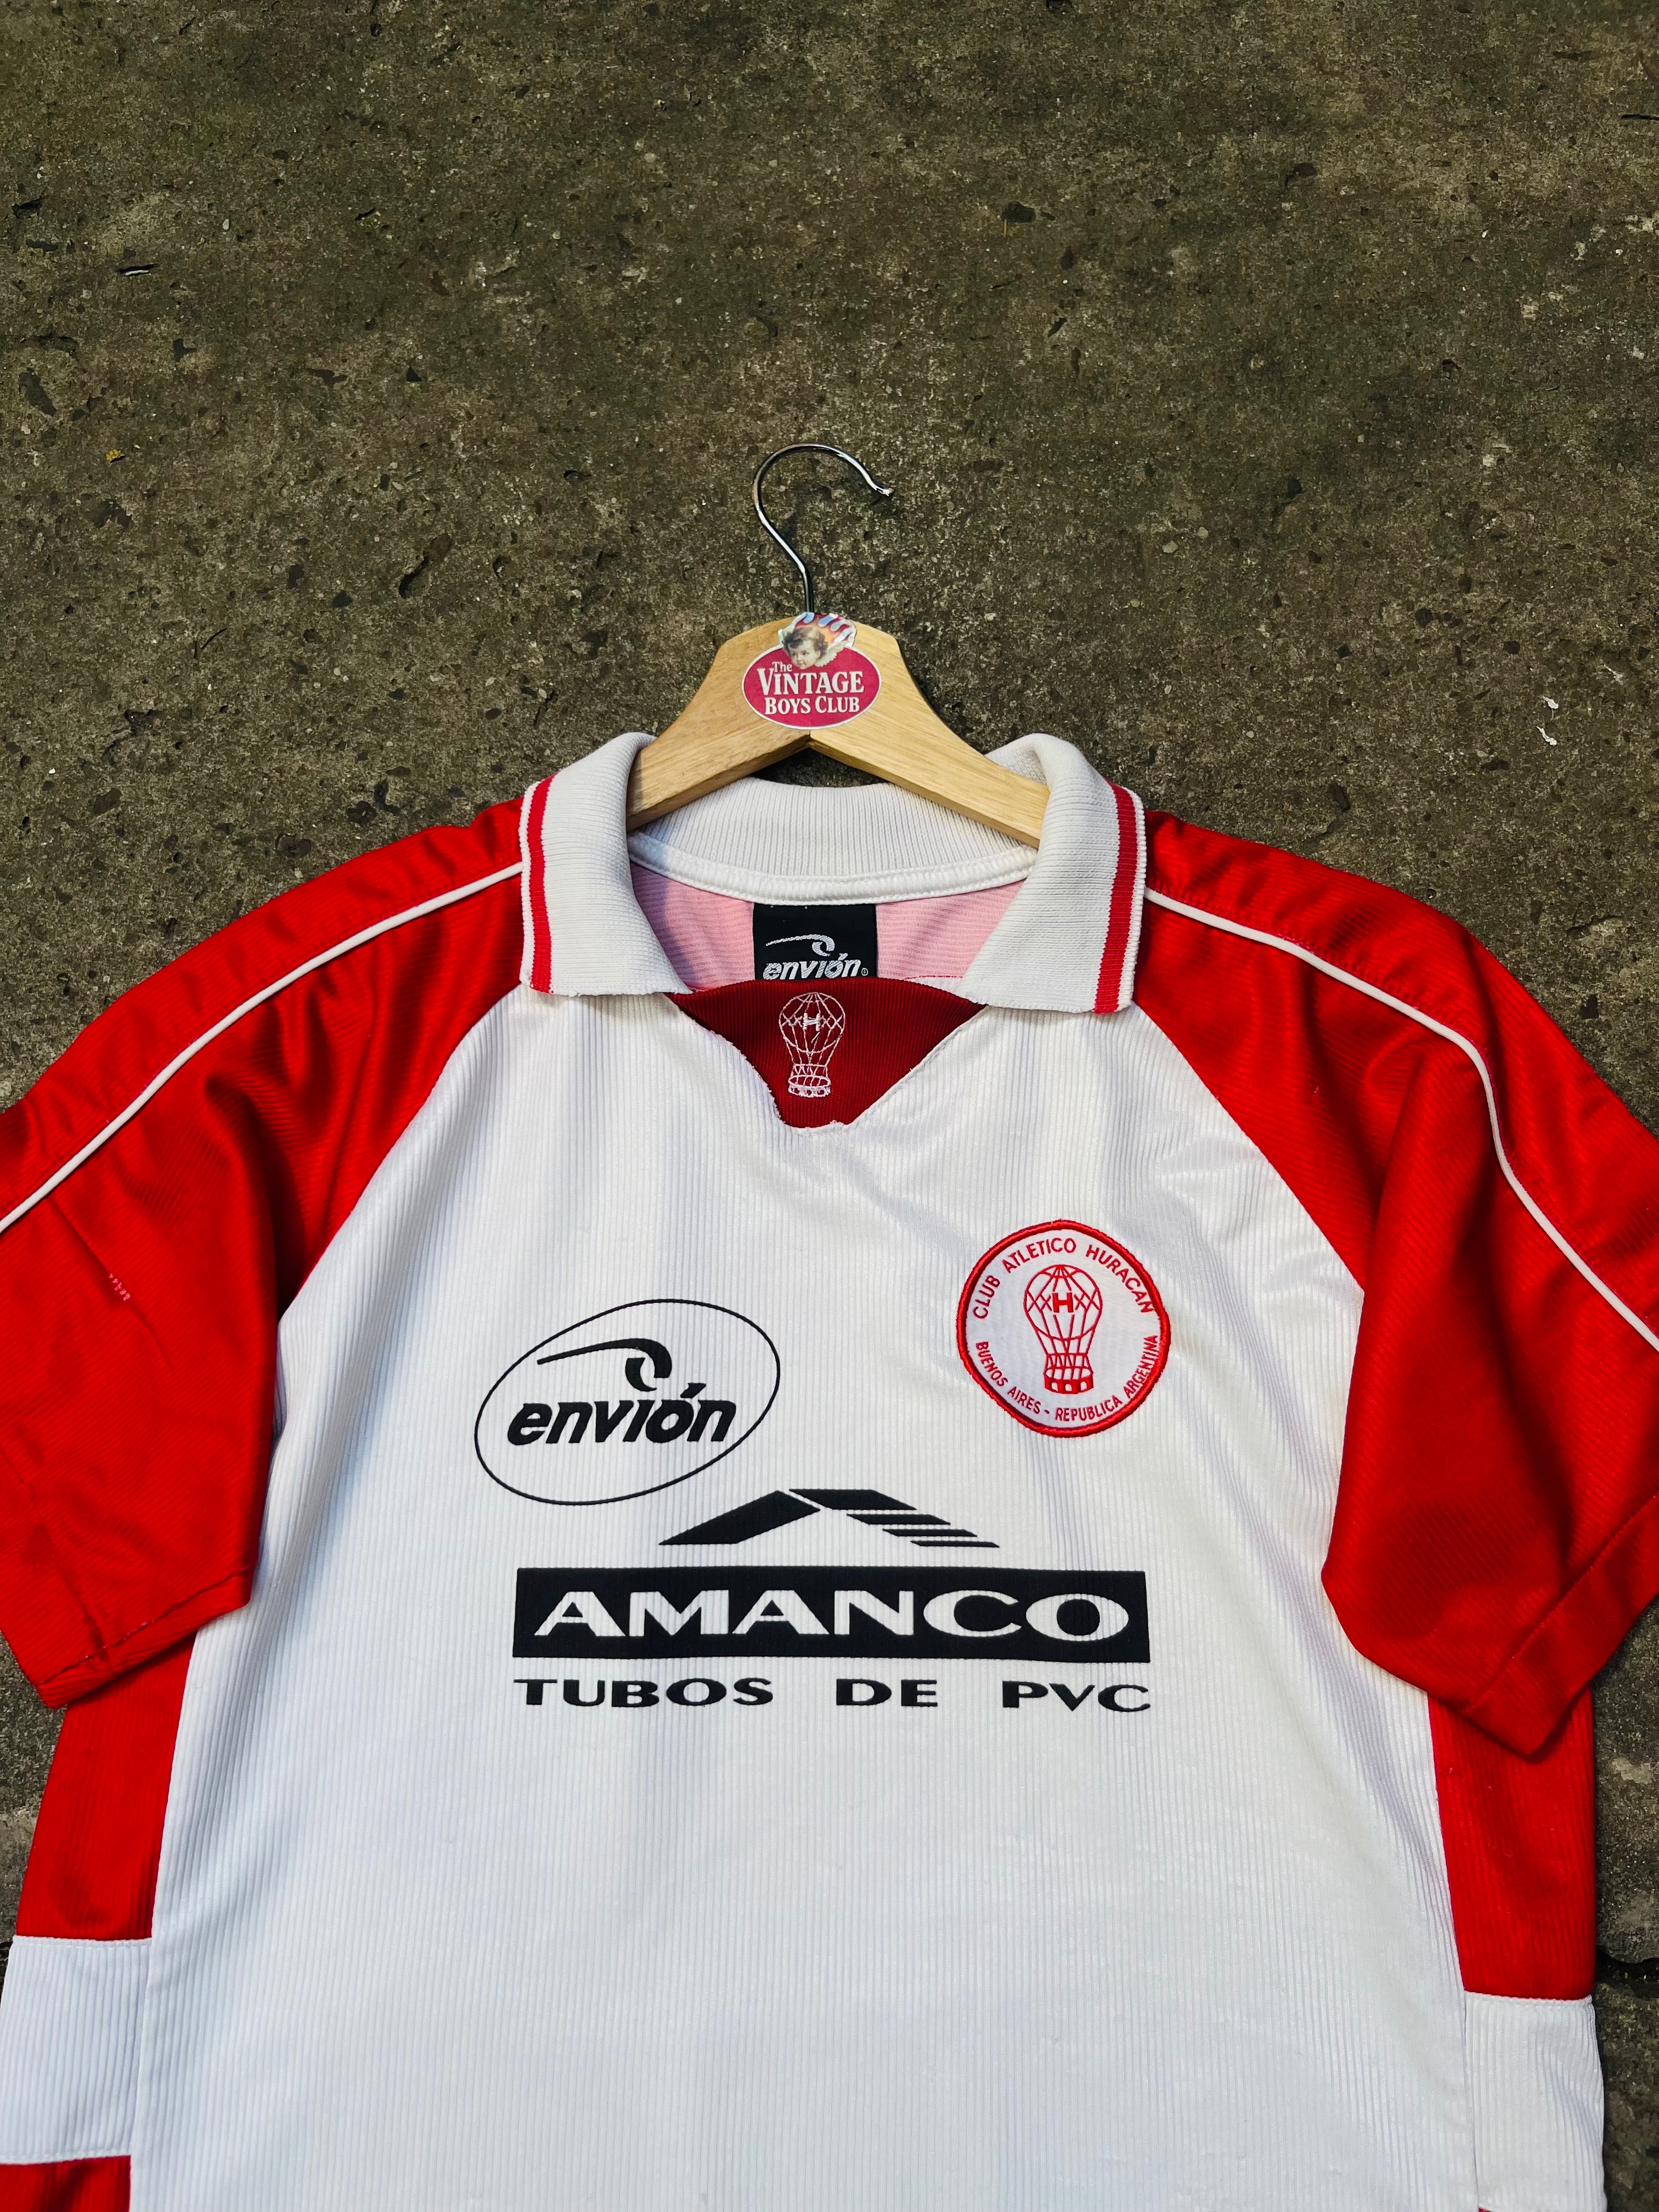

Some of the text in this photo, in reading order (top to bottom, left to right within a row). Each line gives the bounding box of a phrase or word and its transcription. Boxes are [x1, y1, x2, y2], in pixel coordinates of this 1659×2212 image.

[757, 668, 865, 696] VINTAGE
[772, 661, 793, 673] The
[764, 696, 860, 715] BOYS CLUB
[803, 1012, 821, 1031] H
[972, 1238, 1155, 1319] CLUB ATLETICO HURACAN
[1052, 1292, 1075, 1313] H
[975, 1341, 1009, 1387] BUENOS
[1007, 1386, 1042, 1414] AIRES
[1054, 1395, 1123, 1422] REPUBLICA
[1122, 1335, 1159, 1400] ARGENTINA
[507, 1383, 736, 1446] envión
[534, 1589, 1129, 1641] AMANCO
[514, 1677, 1151, 1712] TUBOS DE PVC
